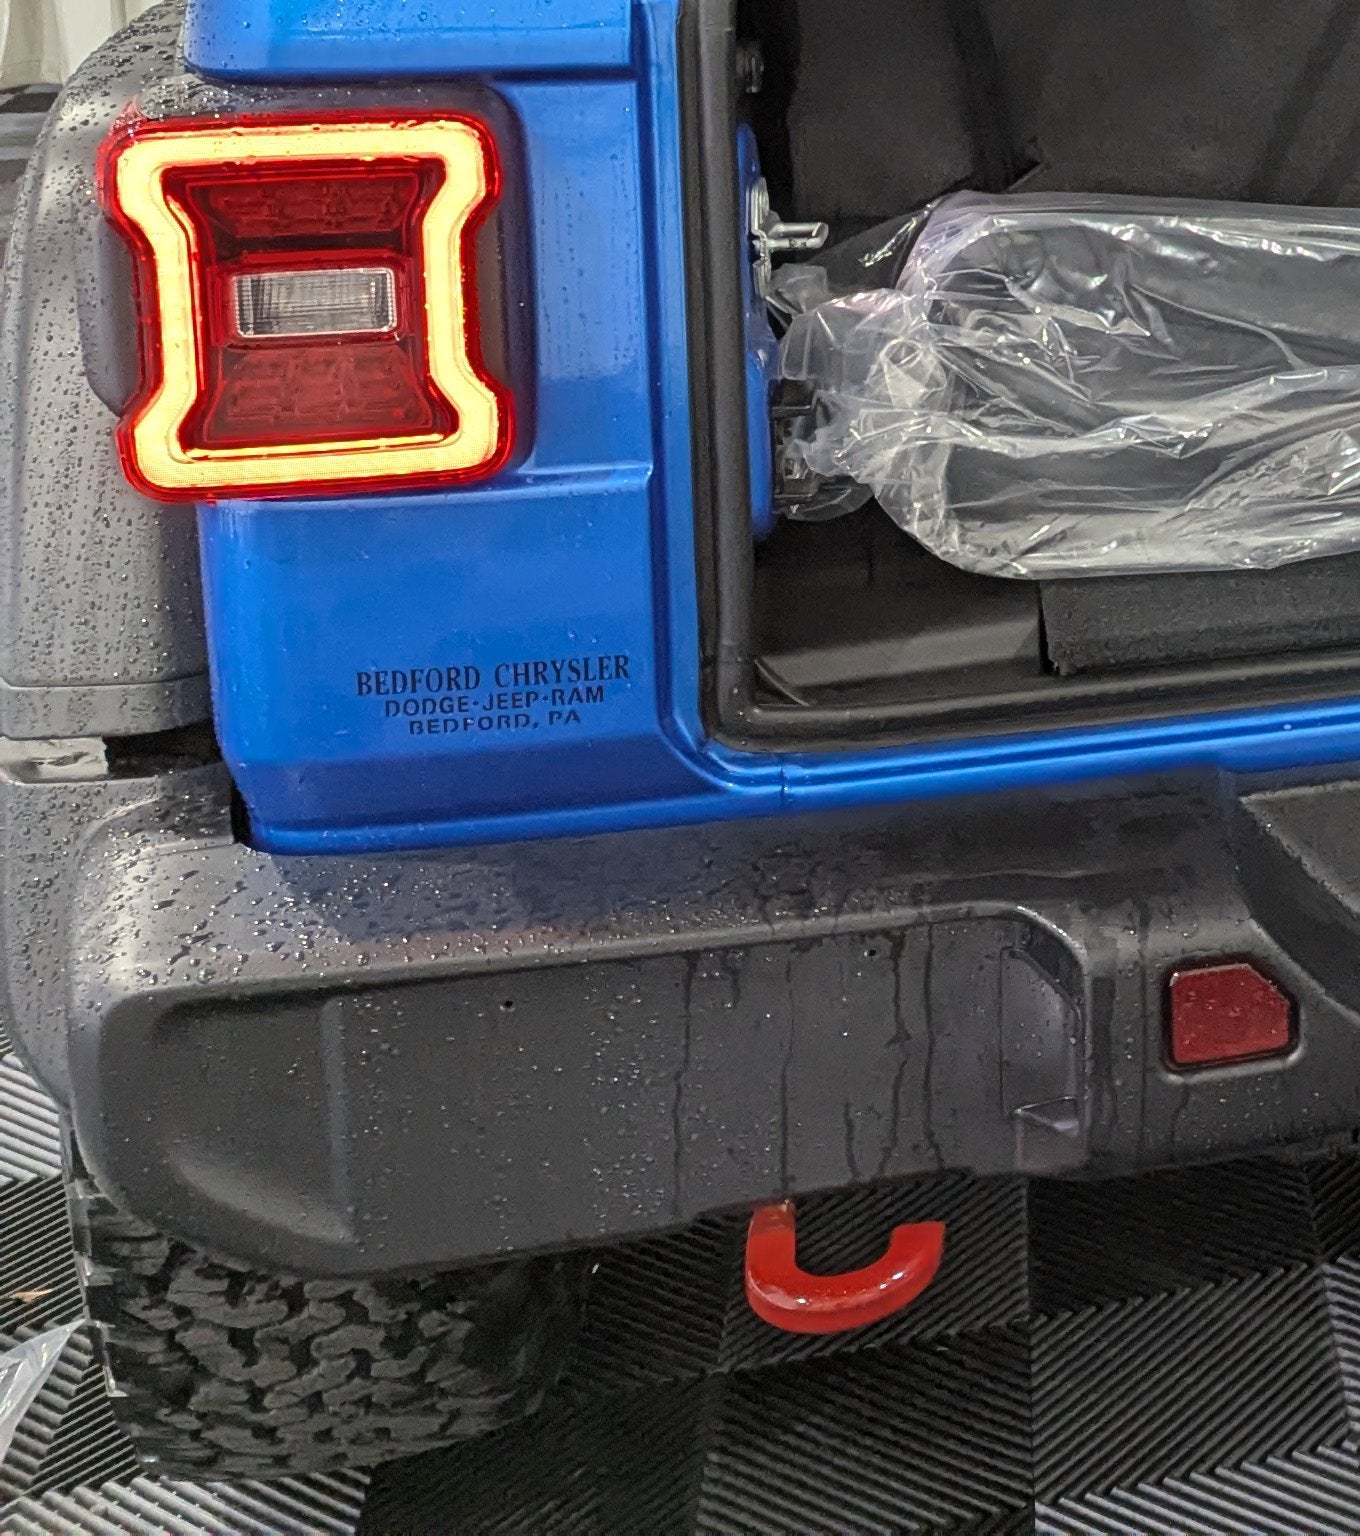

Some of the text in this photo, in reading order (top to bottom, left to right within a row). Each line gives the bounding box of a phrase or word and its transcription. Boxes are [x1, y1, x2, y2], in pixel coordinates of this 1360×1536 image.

[356, 654, 631, 697] BEDFORD CHRYSLER
[408, 709, 582, 736] BEDFORD, PA
